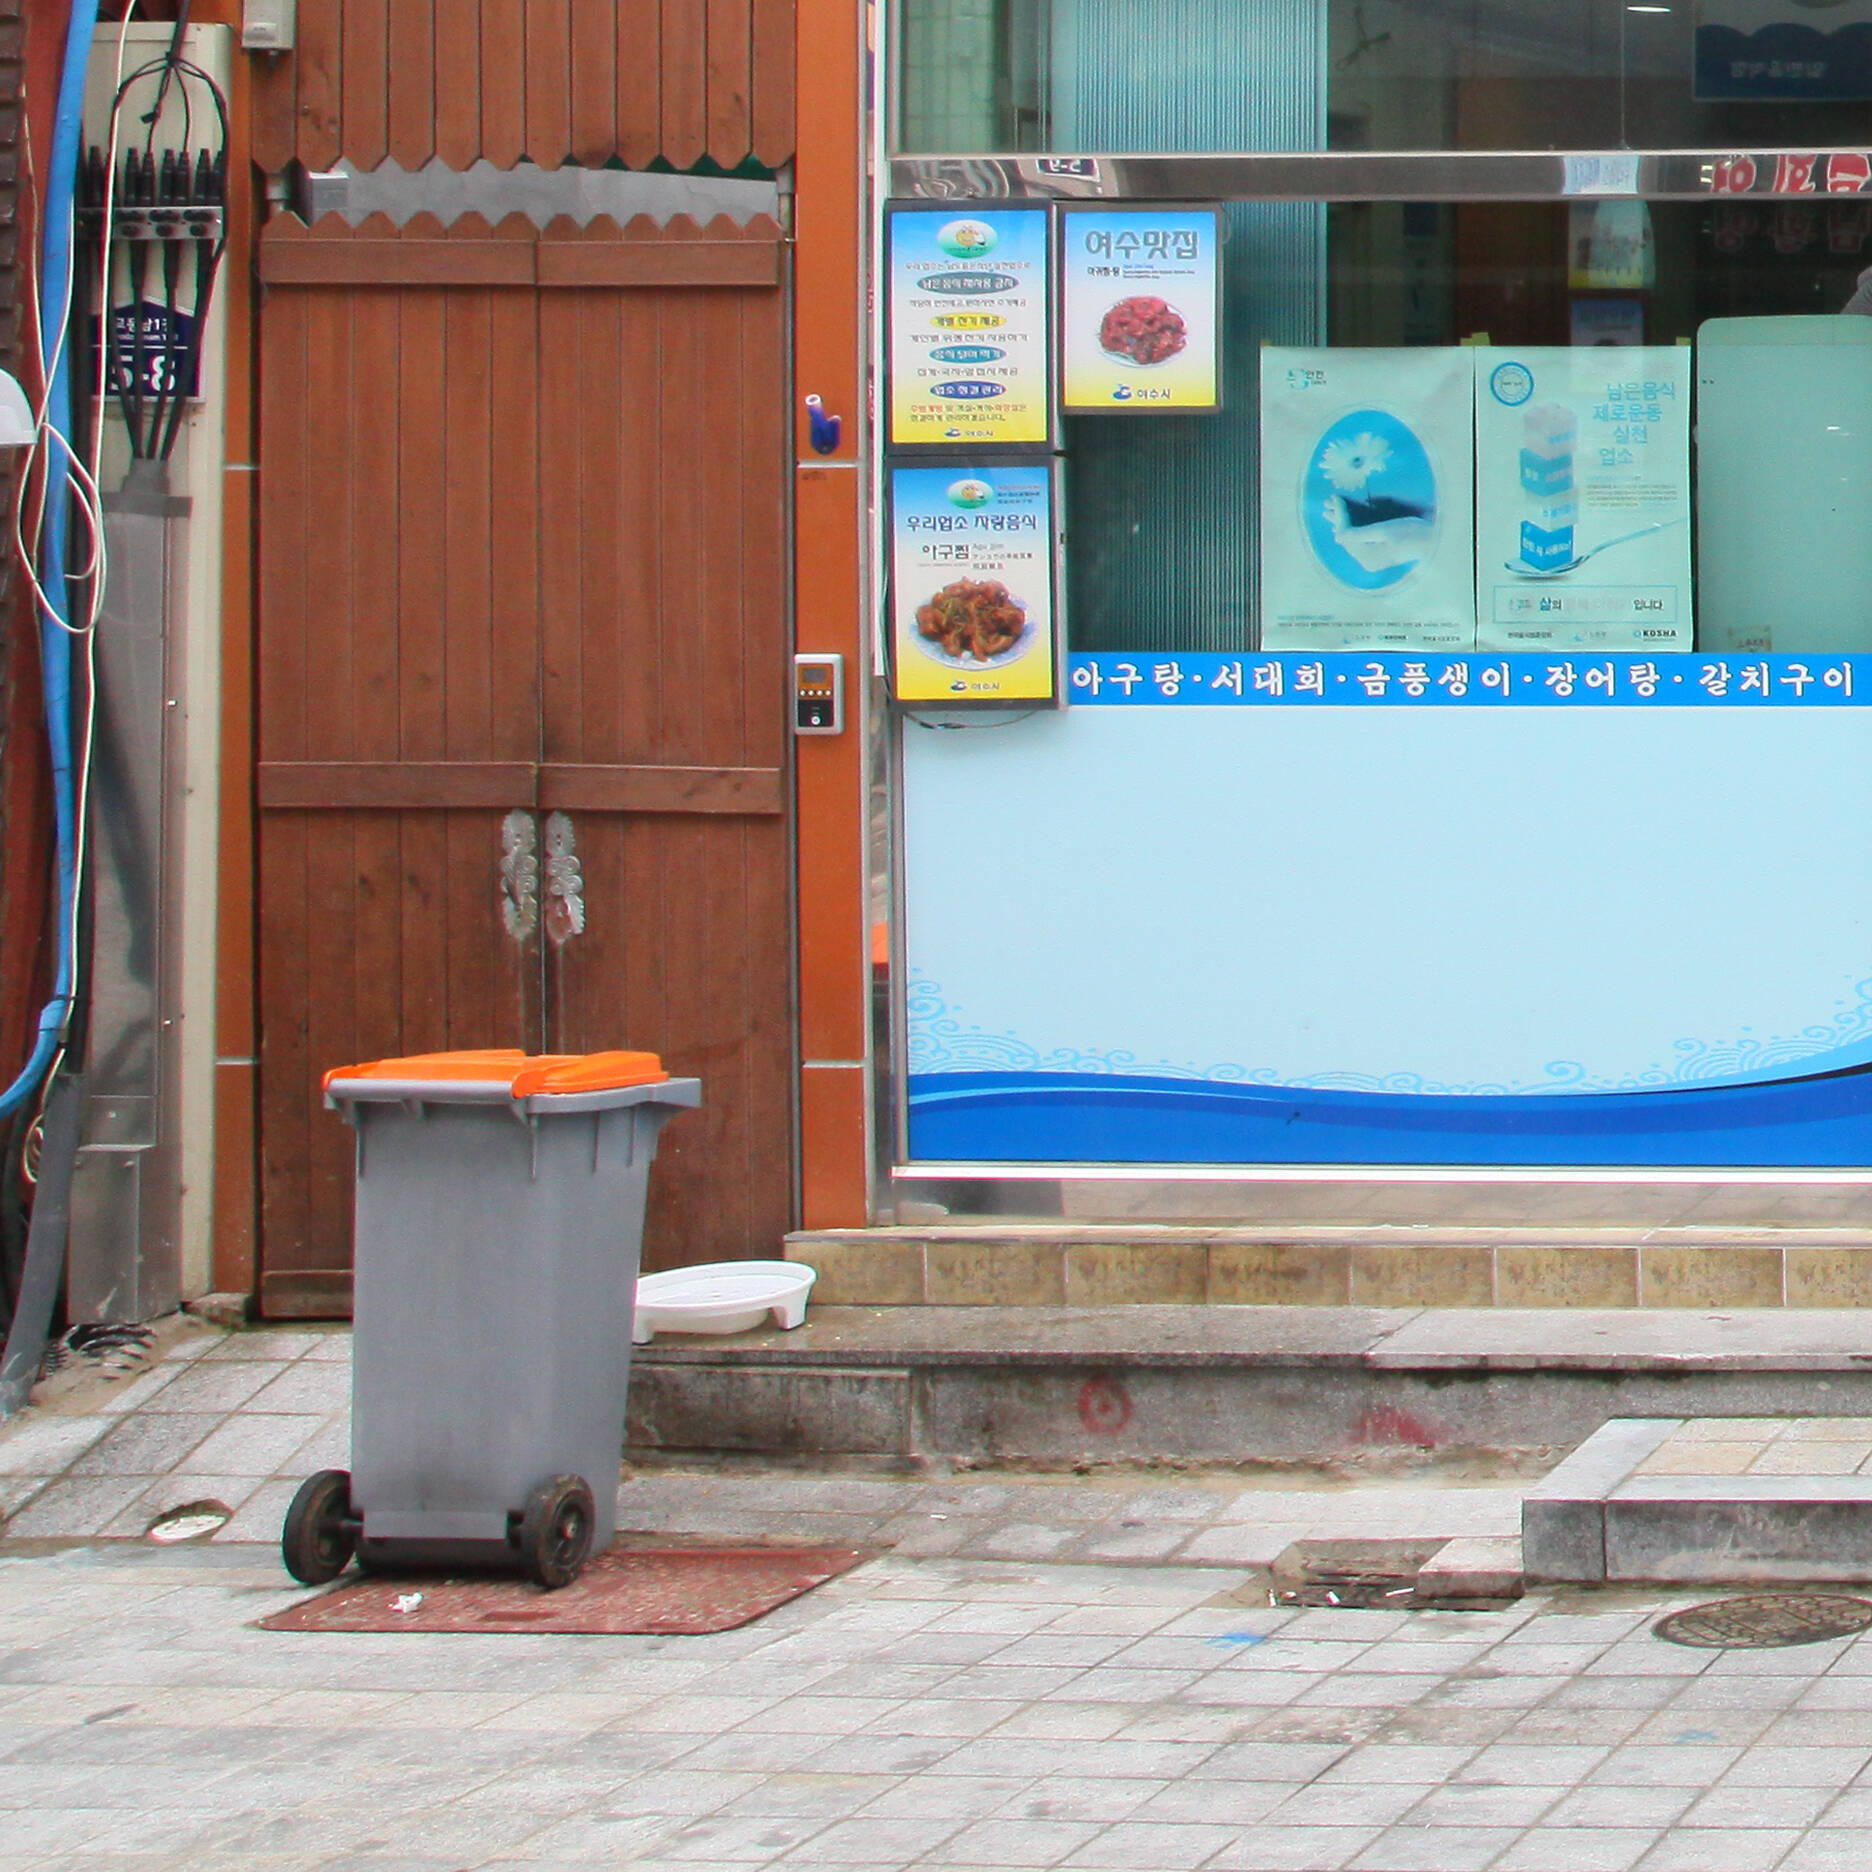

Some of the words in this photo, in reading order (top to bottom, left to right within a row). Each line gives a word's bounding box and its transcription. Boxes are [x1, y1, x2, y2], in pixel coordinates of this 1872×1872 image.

[1085, 231, 1198, 259] 여수맛집
[1137, 388, 1171, 399] 여수시
[1607, 381, 1677, 401] 남은음식
[1593, 403, 1663, 422] 제로운동
[1613, 425, 1649, 444] 실천
[1599, 447, 1634, 466] 업소
[907, 515, 969, 532] 우리업소
[974, 514, 1037, 531] 자랑음식
[922, 544, 970, 560] 아구찜
[1633, 598, 1664, 611] 입니다
[1643, 629, 1677, 638] KOSHA
[1072, 661, 1184, 696] 아구탕
[1210, 661, 1323, 697] 서대회
[1356, 662, 1510, 697] 금풍생이
[1544, 662, 1661, 697] 장어탕
[1699, 661, 1852, 697] 갈치구이
